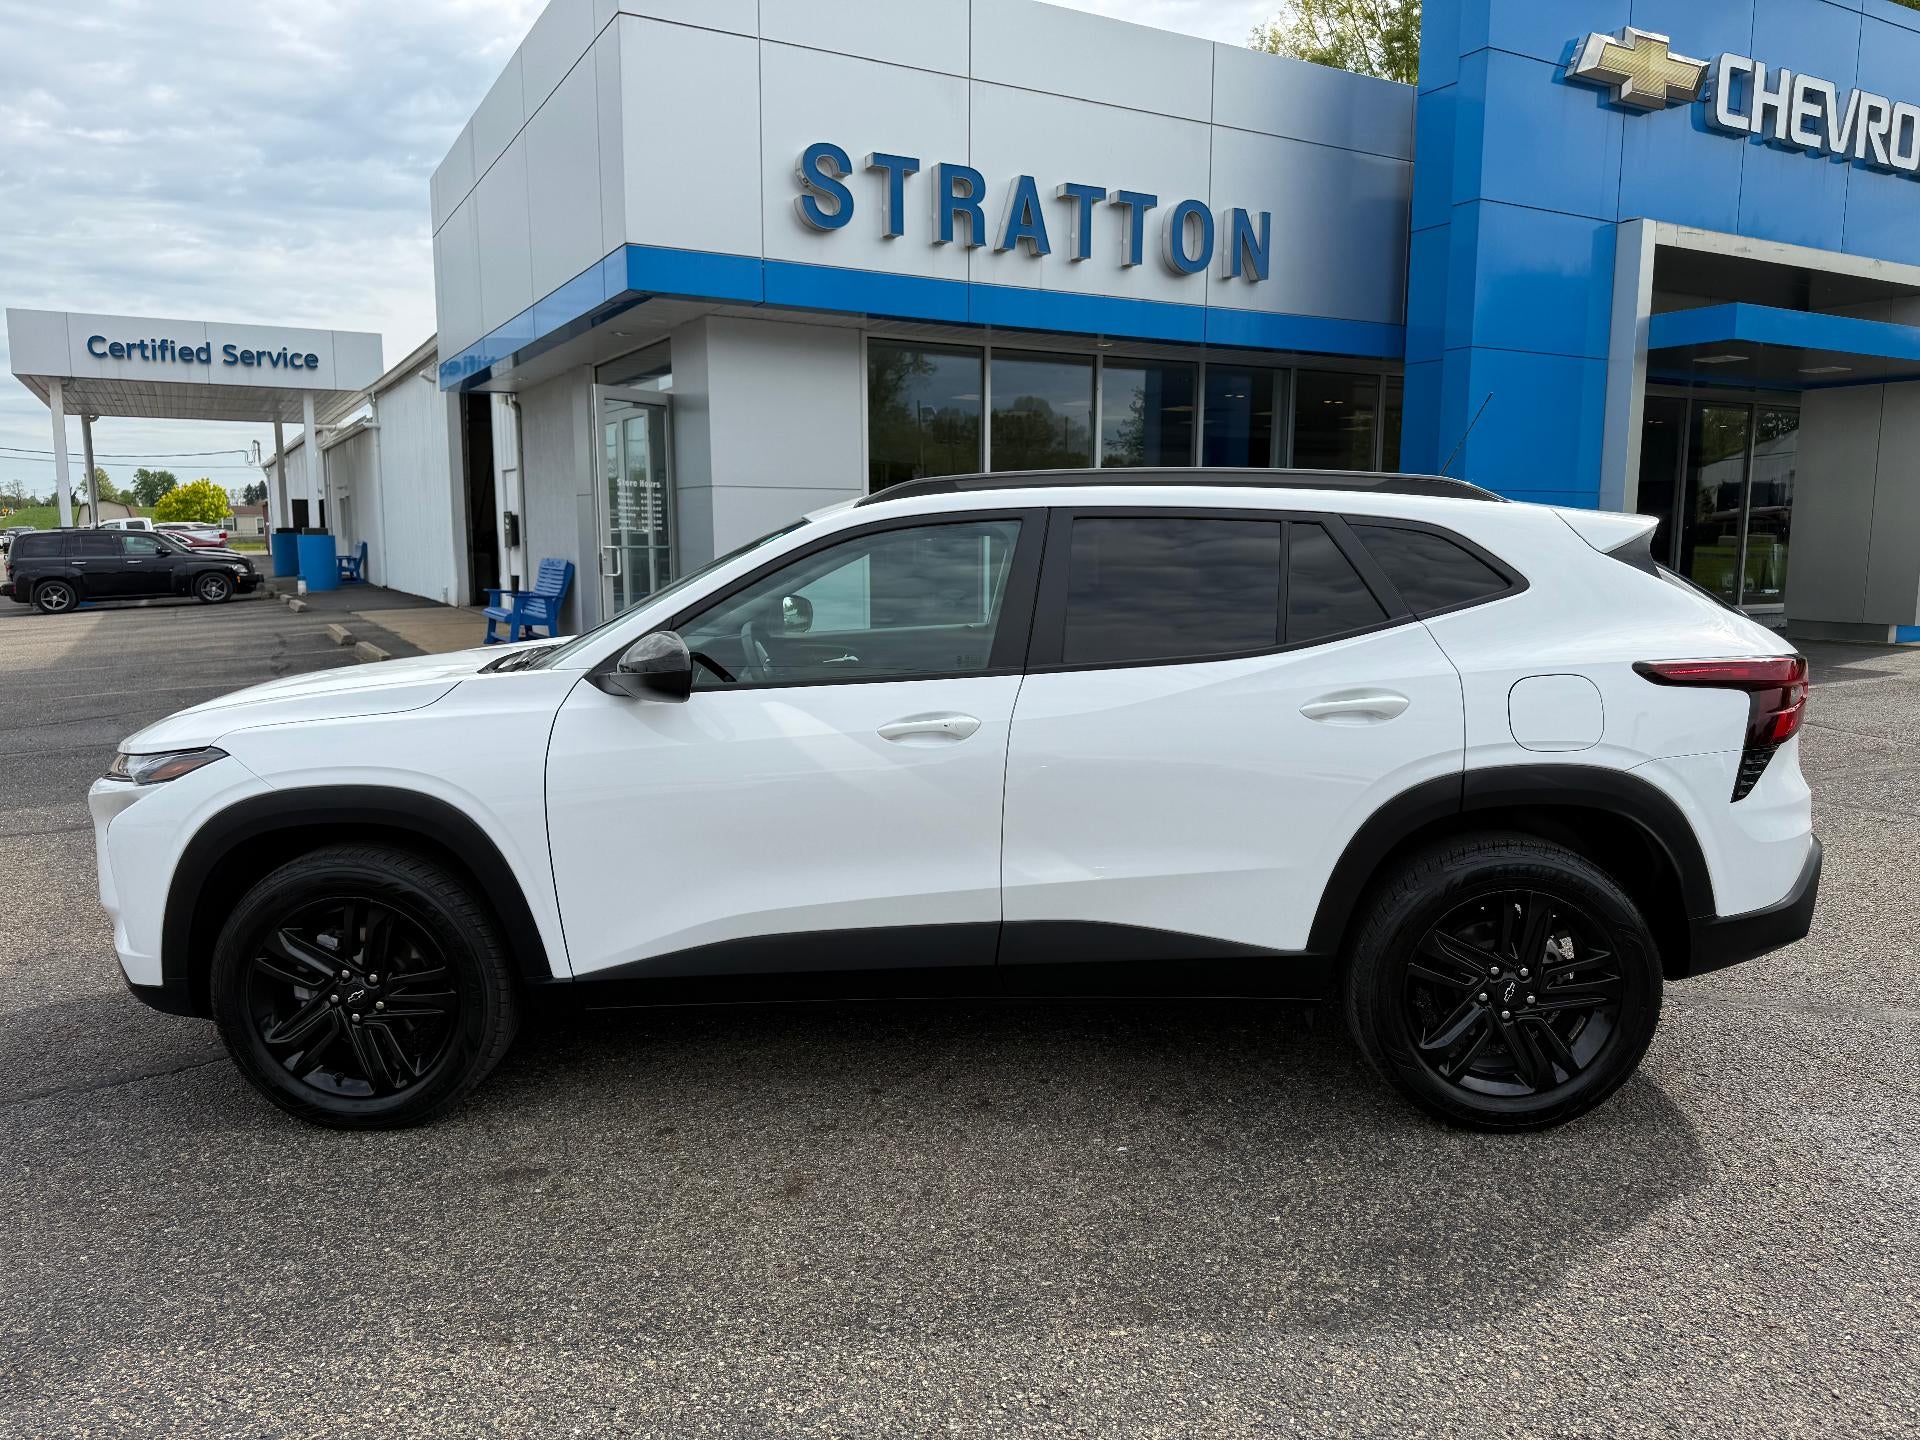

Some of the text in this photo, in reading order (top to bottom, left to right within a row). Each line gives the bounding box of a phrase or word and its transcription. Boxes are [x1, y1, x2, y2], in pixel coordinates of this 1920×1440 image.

[1706, 52, 1920, 171] CHEVRO
[794, 142, 1271, 282] STRATTON
[86, 335, 319, 370] Certified Service
[616, 478, 661, 488] Store Hours
